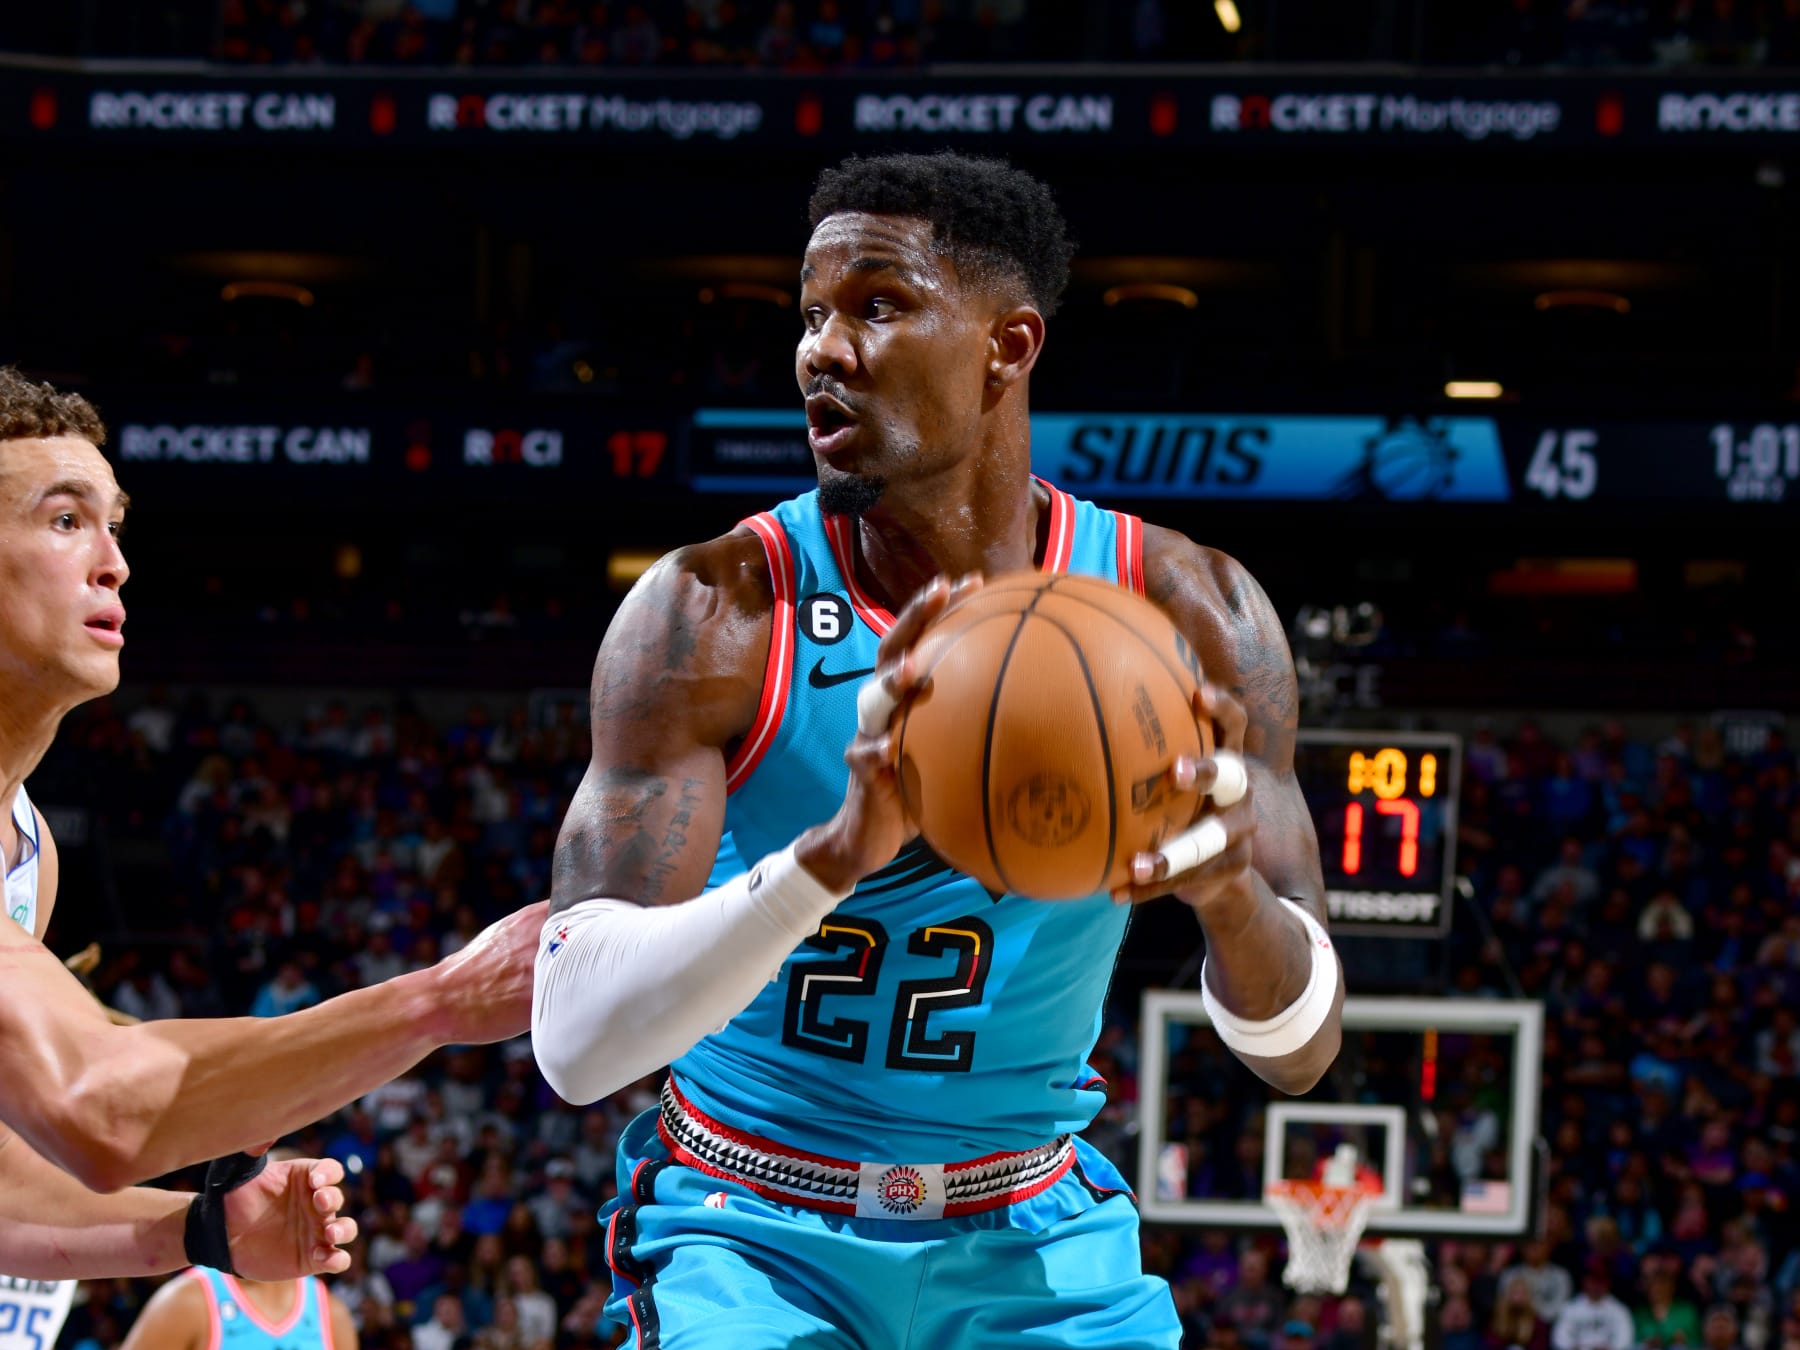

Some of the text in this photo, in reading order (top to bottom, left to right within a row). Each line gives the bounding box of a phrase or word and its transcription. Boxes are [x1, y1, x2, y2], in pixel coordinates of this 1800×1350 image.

[90, 93, 334, 128] ROCKET CAN
[428, 94, 760, 137] ROCKET Mortgage
[855, 94, 1112, 130] ROCKET CAN
[1211, 94, 1558, 138] ROCKET Mortgage
[121, 426, 369, 462] ROCKET CAN
[608, 431, 668, 477] 17
[1060, 416, 1273, 486] SUNS
[1526, 430, 1597, 499] 45
[1709, 423, 1800, 480] 1:01
[811, 600, 840, 639] 6
[1342, 797, 1421, 877] 17
[1326, 890, 1440, 920] TISSOT
[781, 914, 995, 1074] 22
[889, 1185, 917, 1197] PHX
